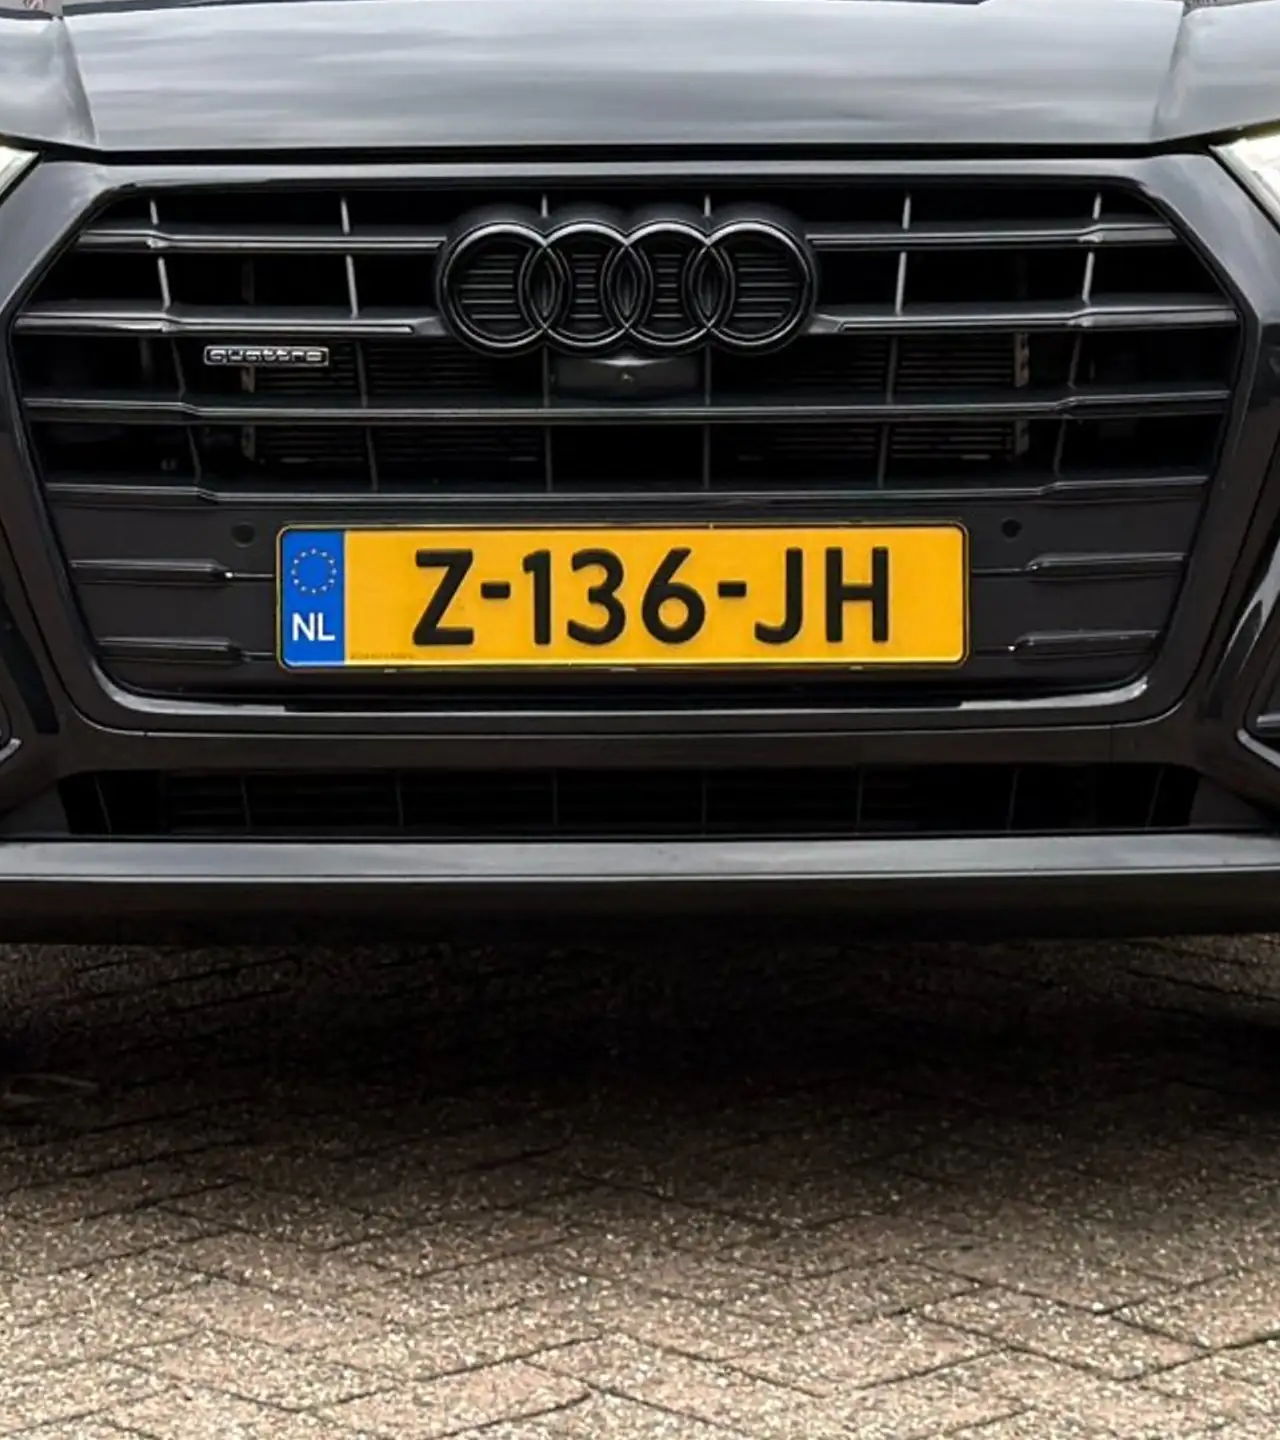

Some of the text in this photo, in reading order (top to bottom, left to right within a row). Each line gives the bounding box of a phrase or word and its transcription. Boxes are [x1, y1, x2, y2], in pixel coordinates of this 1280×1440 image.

[209, 348, 323, 364] quattro
[412, 547, 889, 647] Z-136-JH
[291, 612, 336, 642] NL
